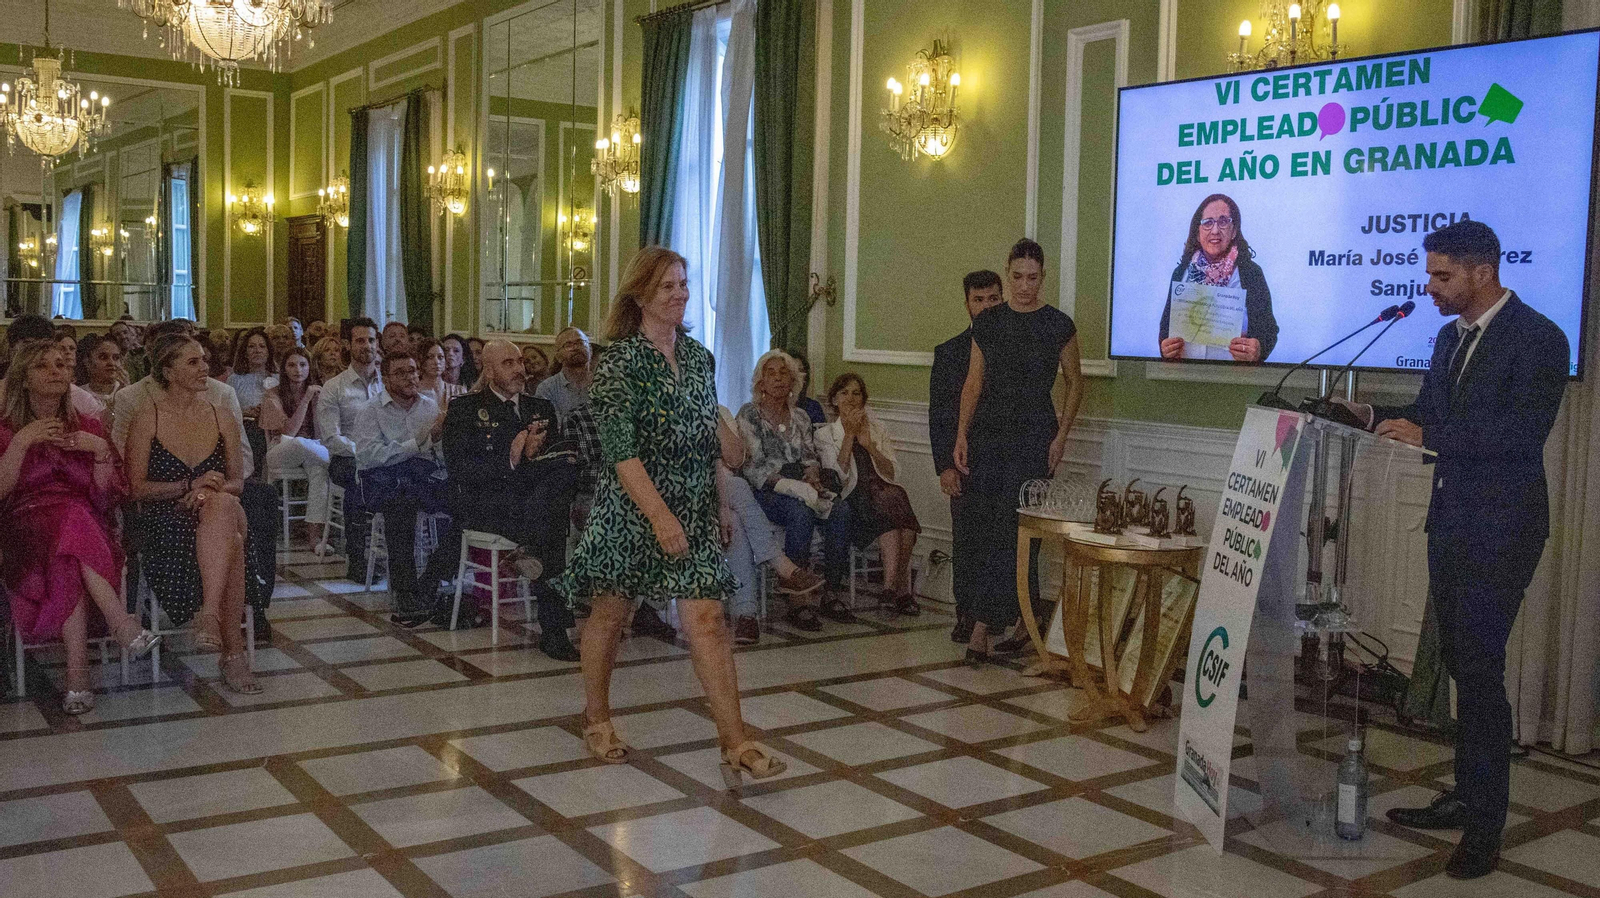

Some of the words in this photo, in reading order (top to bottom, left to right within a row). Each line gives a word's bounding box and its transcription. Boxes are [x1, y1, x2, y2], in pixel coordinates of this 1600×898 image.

[1215, 80, 1240, 105] VI
[1251, 57, 1431, 102] CERTAMEN
[1157, 162, 1209, 186] DEL
[1217, 150, 1280, 182] AÑO
[1290, 150, 1332, 177] EN
[1343, 136, 1516, 174] GRANADA
[1308, 249, 1363, 267] María
[1370, 248, 1419, 266] José
[1370, 279, 1428, 300] Sanju
[1396, 355, 1431, 368] Grana
[1255, 449, 1267, 469] VI
[1227, 471, 1280, 505] CERTAMEN
[1213, 551, 1229, 577] DEL
[1230, 560, 1253, 588] AÑO
[1202, 649, 1230, 688] CSIF
